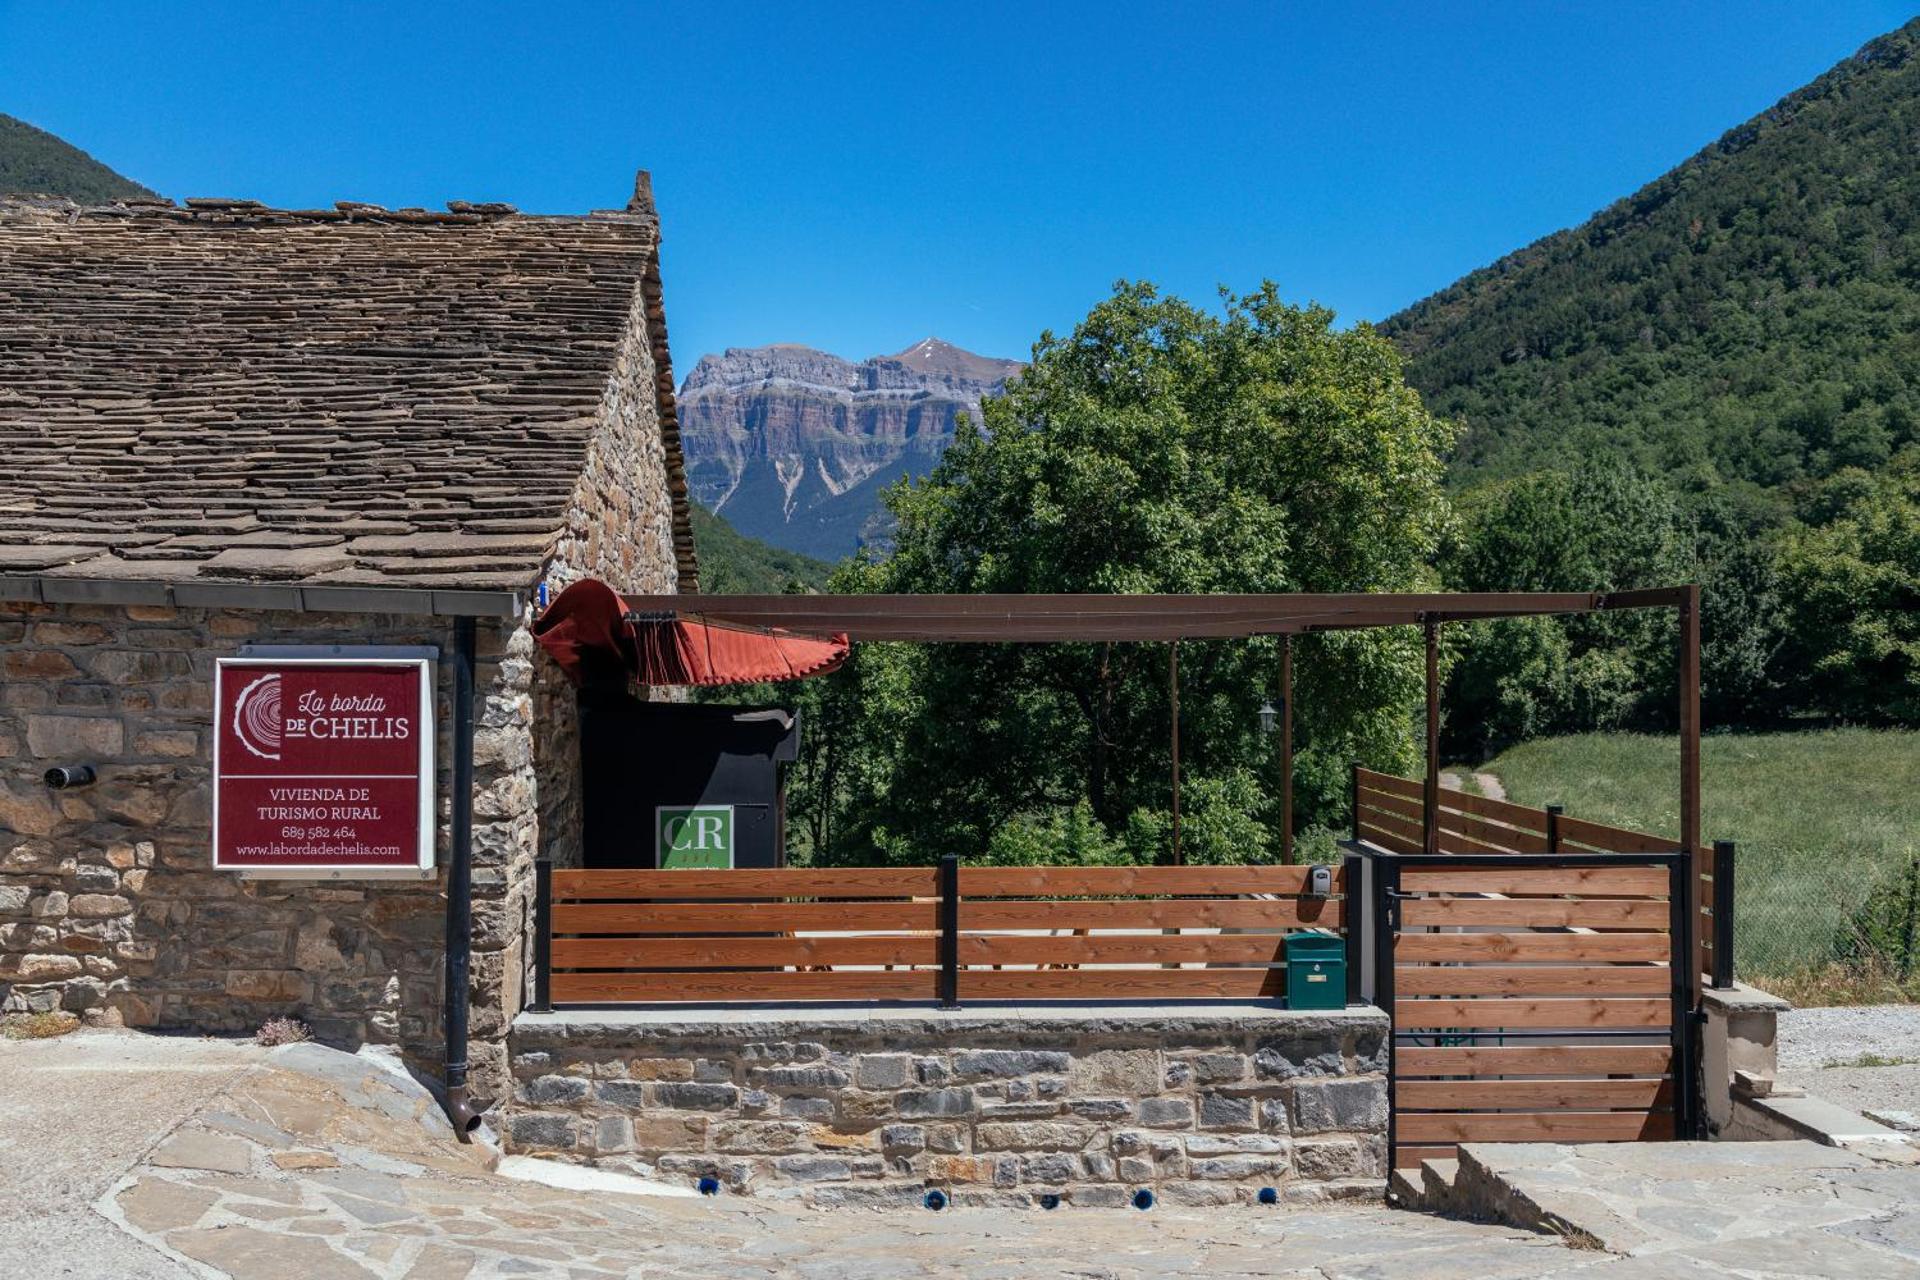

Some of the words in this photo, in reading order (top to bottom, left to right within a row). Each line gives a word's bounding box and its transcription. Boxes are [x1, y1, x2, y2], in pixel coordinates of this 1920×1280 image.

[298, 689, 325, 717] La
[330, 693, 386, 712] borda
[286, 718, 307, 734] DE
[310, 717, 409, 739] CHELIS
[270, 788, 345, 801] VIVIENDA
[349, 788, 369, 801] DE
[257, 807, 328, 820] TURISMO
[331, 807, 381, 820] RURAL
[282, 826, 304, 840] 689
[308, 826, 330, 840] 582
[333, 826, 356, 839] 464
[664, 816, 726, 851] CR
[236, 842, 400, 857] www.labordadechelis.com
